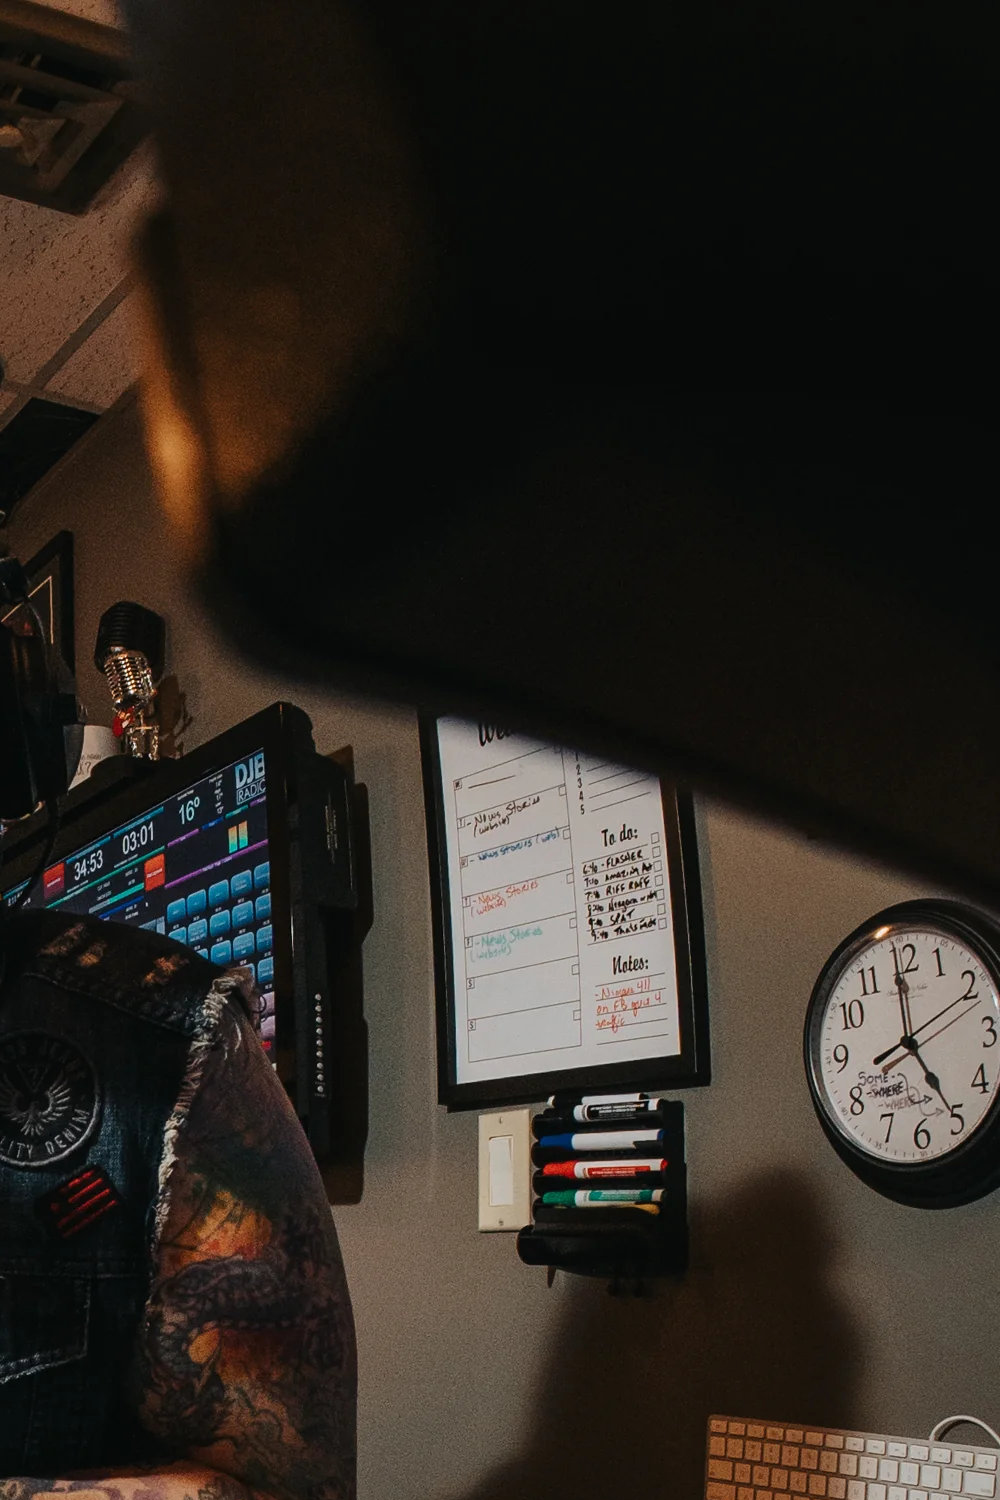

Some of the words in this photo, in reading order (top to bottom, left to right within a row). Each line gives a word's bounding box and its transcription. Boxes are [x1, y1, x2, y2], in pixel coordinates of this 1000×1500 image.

[576, 764, 581, 775] 2
[577, 777, 583, 788] 3
[579, 791, 584, 801] 4
[580, 804, 585, 815] 5
[122, 821, 154, 855] 03:01
[601, 828, 616, 847] To
[620, 823, 638, 842] do:
[74, 850, 103, 881] 34:53
[612, 955, 649, 975] Notes:
[889, 943, 919, 976] 12
[932, 948, 946, 978] 1
[857, 966, 881, 997] 11
[960, 970, 979, 1001] 2
[840, 999, 865, 1031] 10
[981, 1015, 998, 1048] 3
[833, 1044, 849, 1074] 9
[970, 1063, 990, 1094] 4
[849, 1086, 865, 1116] 8
[45, 1108, 91, 1155] DENIM
[880, 1113, 894, 1143] 7
[913, 1118, 931, 1149] 6
[950, 1103, 964, 1135] 5
